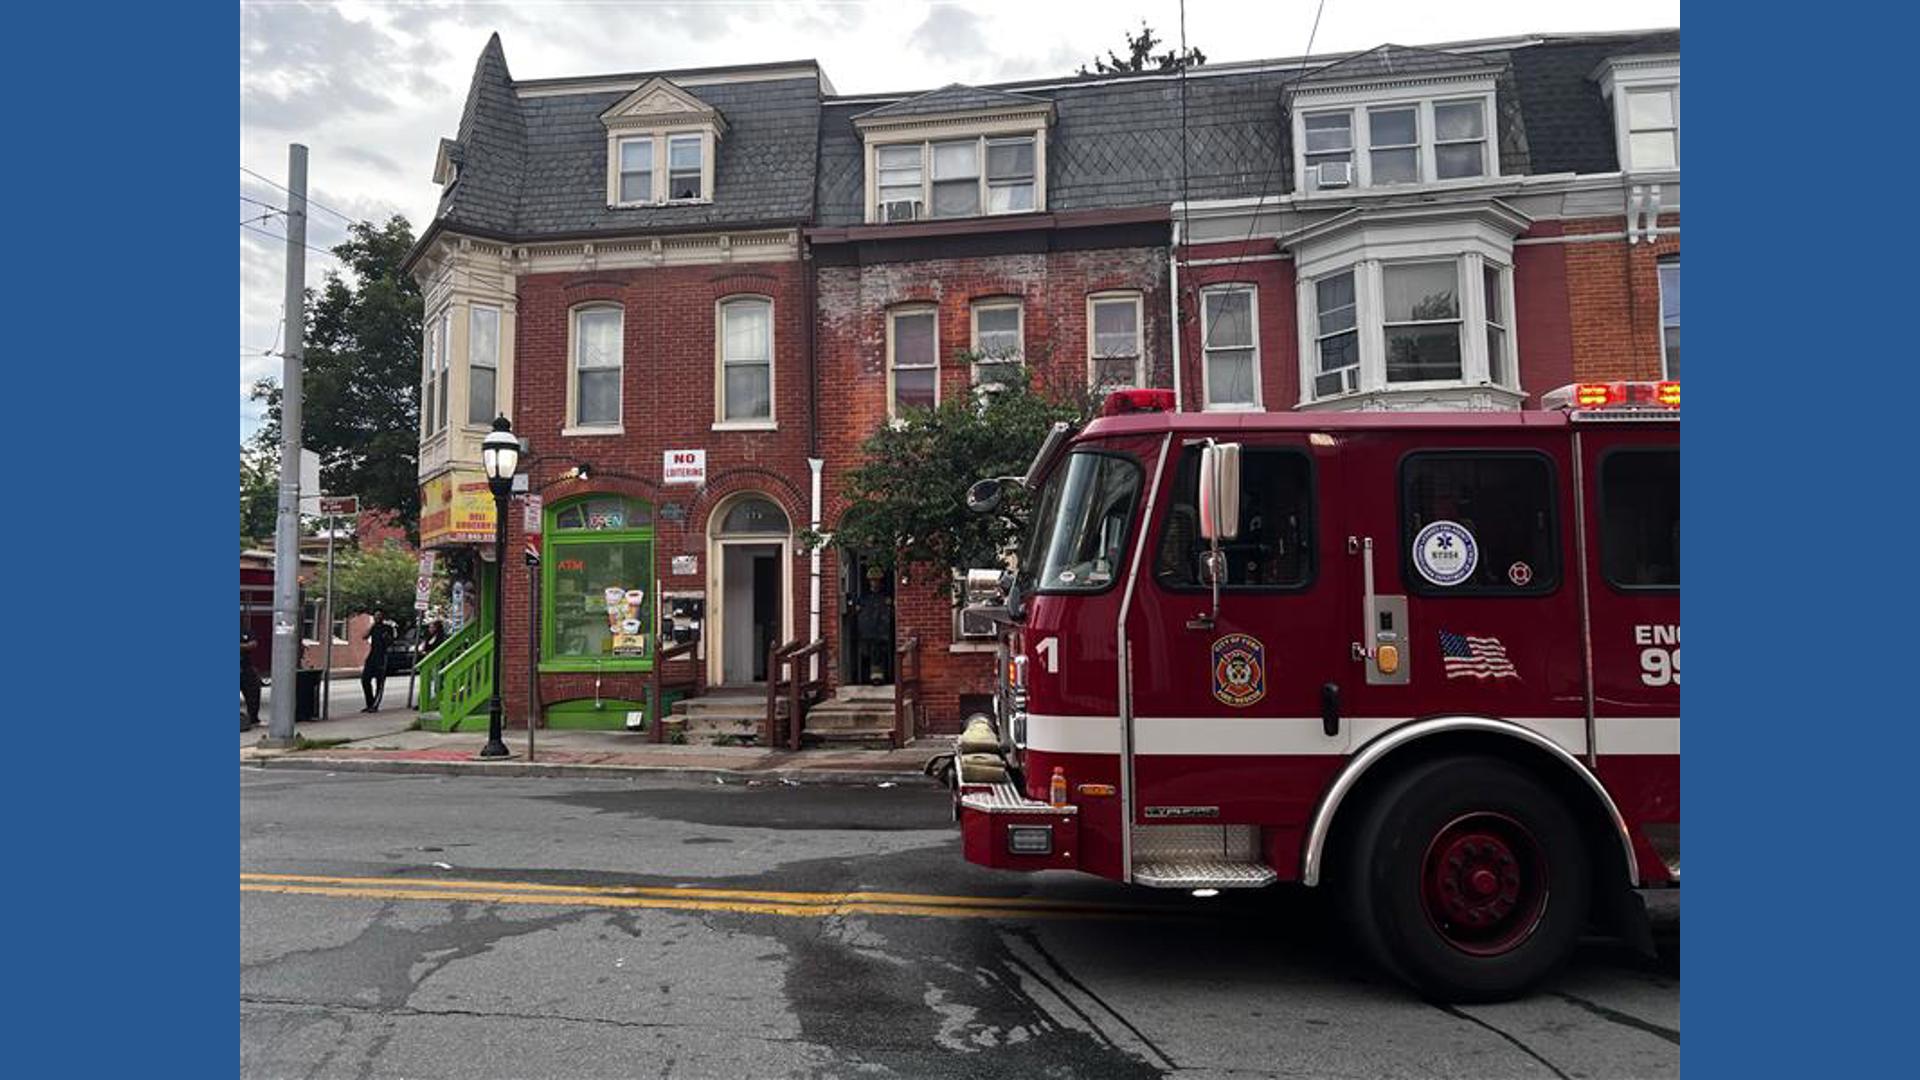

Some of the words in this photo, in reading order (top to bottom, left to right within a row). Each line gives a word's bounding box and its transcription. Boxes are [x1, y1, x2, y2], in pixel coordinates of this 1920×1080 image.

[674, 453, 696, 464] NO
[588, 512, 623, 528] OPEN
[558, 560, 585, 570] ATM
[1035, 637, 1058, 673] 1
[1641, 648, 1680, 686] 9
